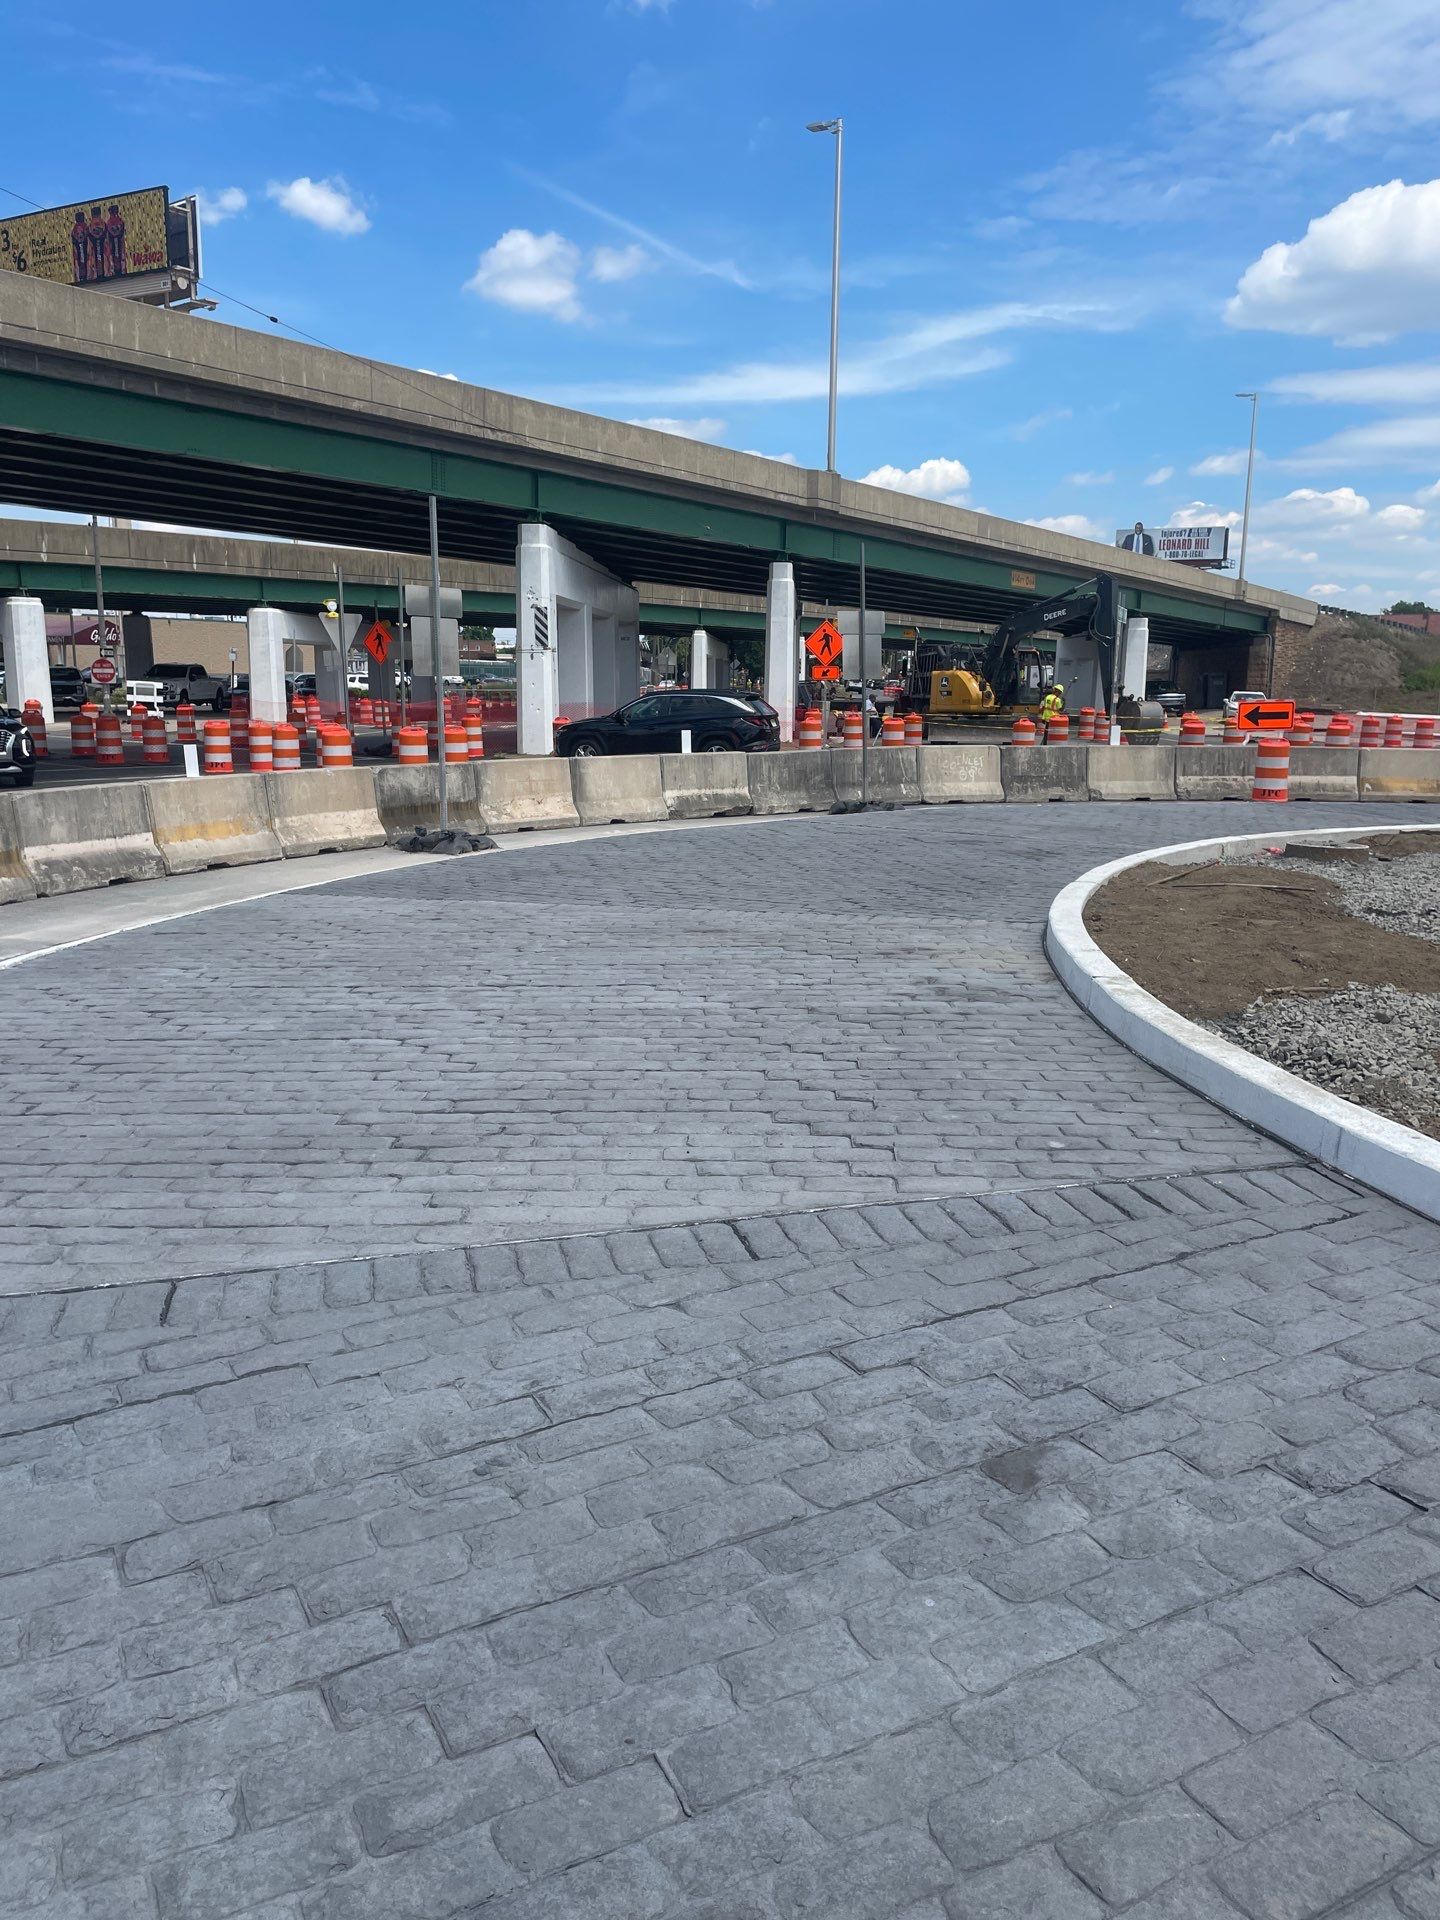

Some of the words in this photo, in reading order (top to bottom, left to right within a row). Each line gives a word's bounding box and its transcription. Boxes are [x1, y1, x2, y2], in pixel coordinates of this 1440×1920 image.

[1, 229, 11, 251] 3
[32, 236, 47, 248] Real
[32, 244, 66, 259] Hydration
[133, 250, 164, 266] Wawa
[1161, 528, 1187, 538] Injured?
[1159, 538, 1192, 551] LEONARD
[1194, 538, 1210, 550] HILL
[1043, 608, 1067, 621] DEERE
[208, 761, 226, 769] JPC
[1260, 789, 1281, 797] JPC
